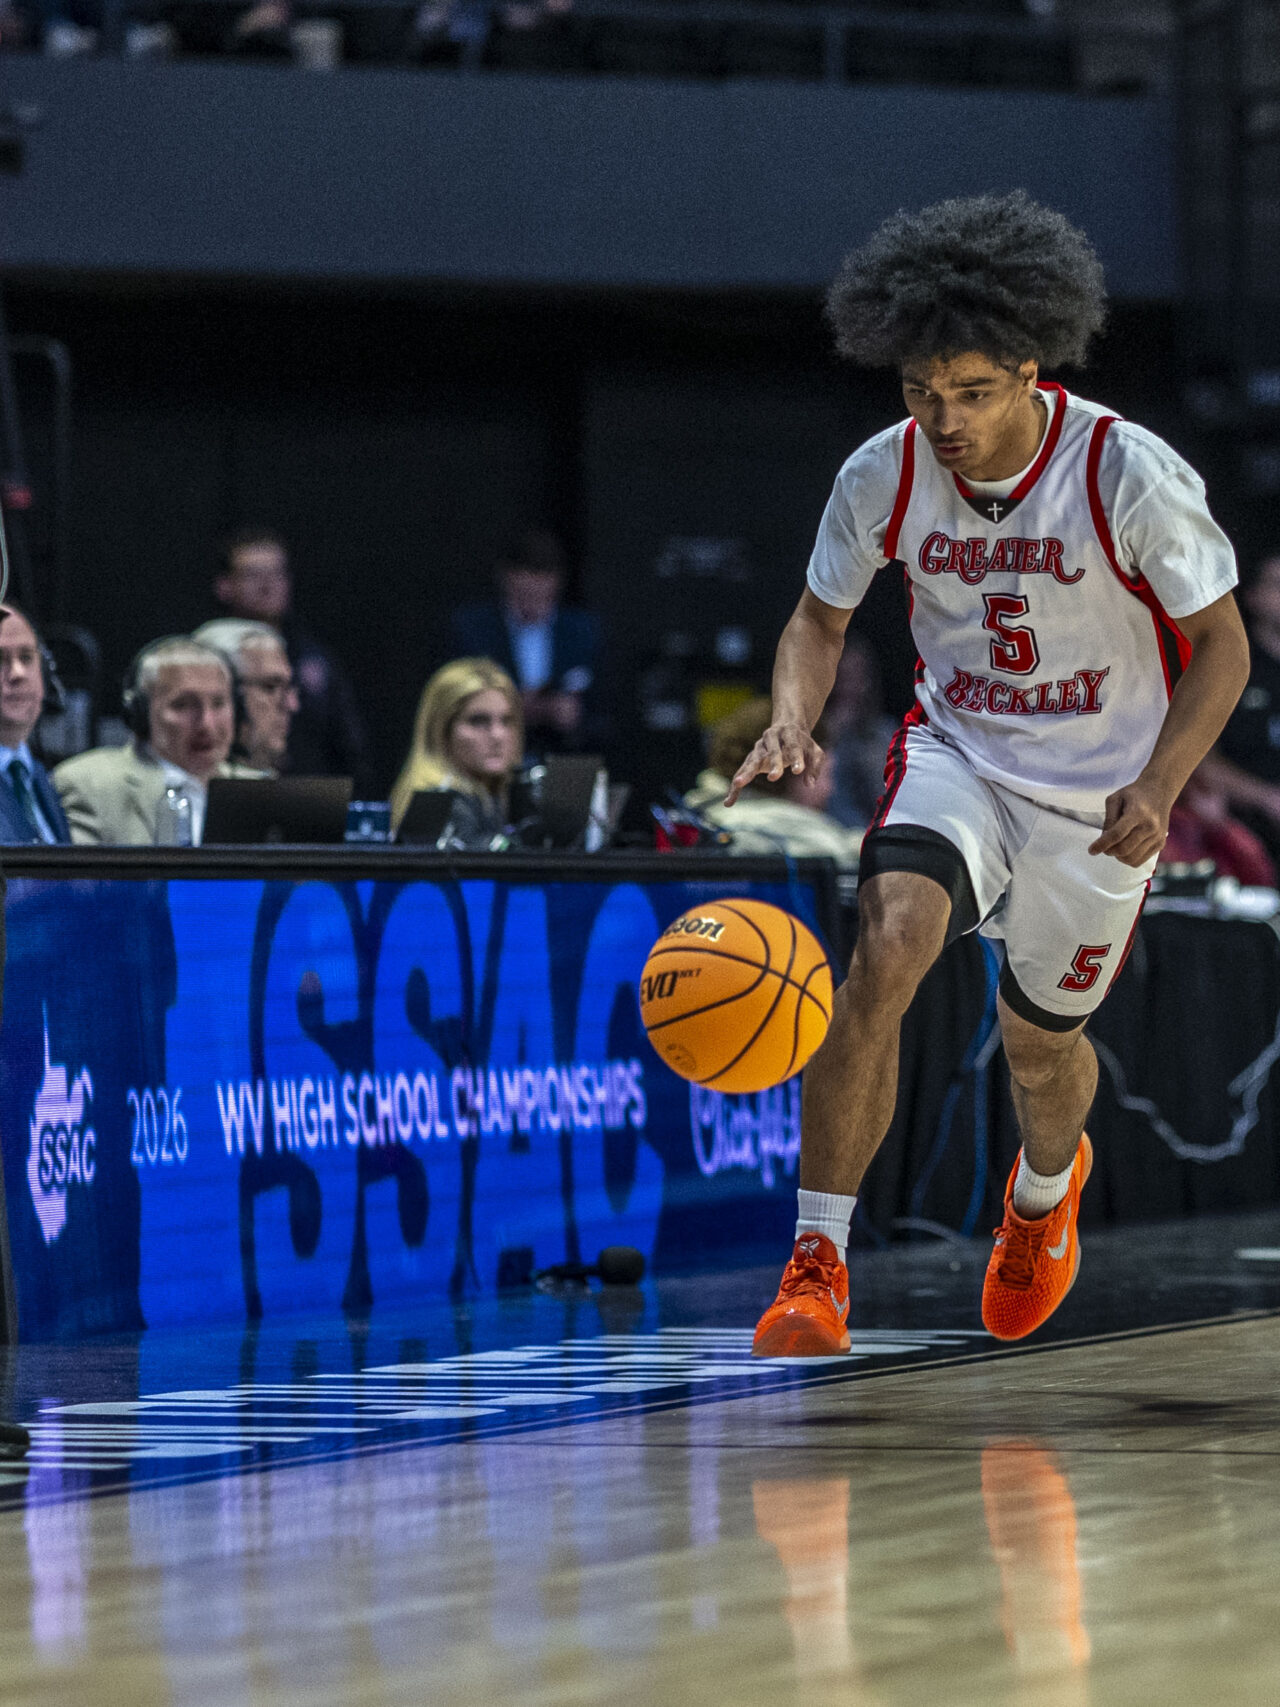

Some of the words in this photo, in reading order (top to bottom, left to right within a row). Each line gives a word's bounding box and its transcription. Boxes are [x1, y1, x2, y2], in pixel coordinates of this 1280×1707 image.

[918, 531, 1085, 585] GREATER
[982, 592, 1040, 675] 5
[944, 666, 1110, 715] BECKLEY
[1057, 943, 1112, 993] 5
[127, 1086, 188, 1165] 2026
[215, 1078, 264, 1156] WV
[271, 1076, 338, 1152] HIGH
[343, 1069, 450, 1148] SCHOOL
[451, 1058, 647, 1137] CHAMPIONSHIPS
[40, 1126, 96, 1186] SSAC
